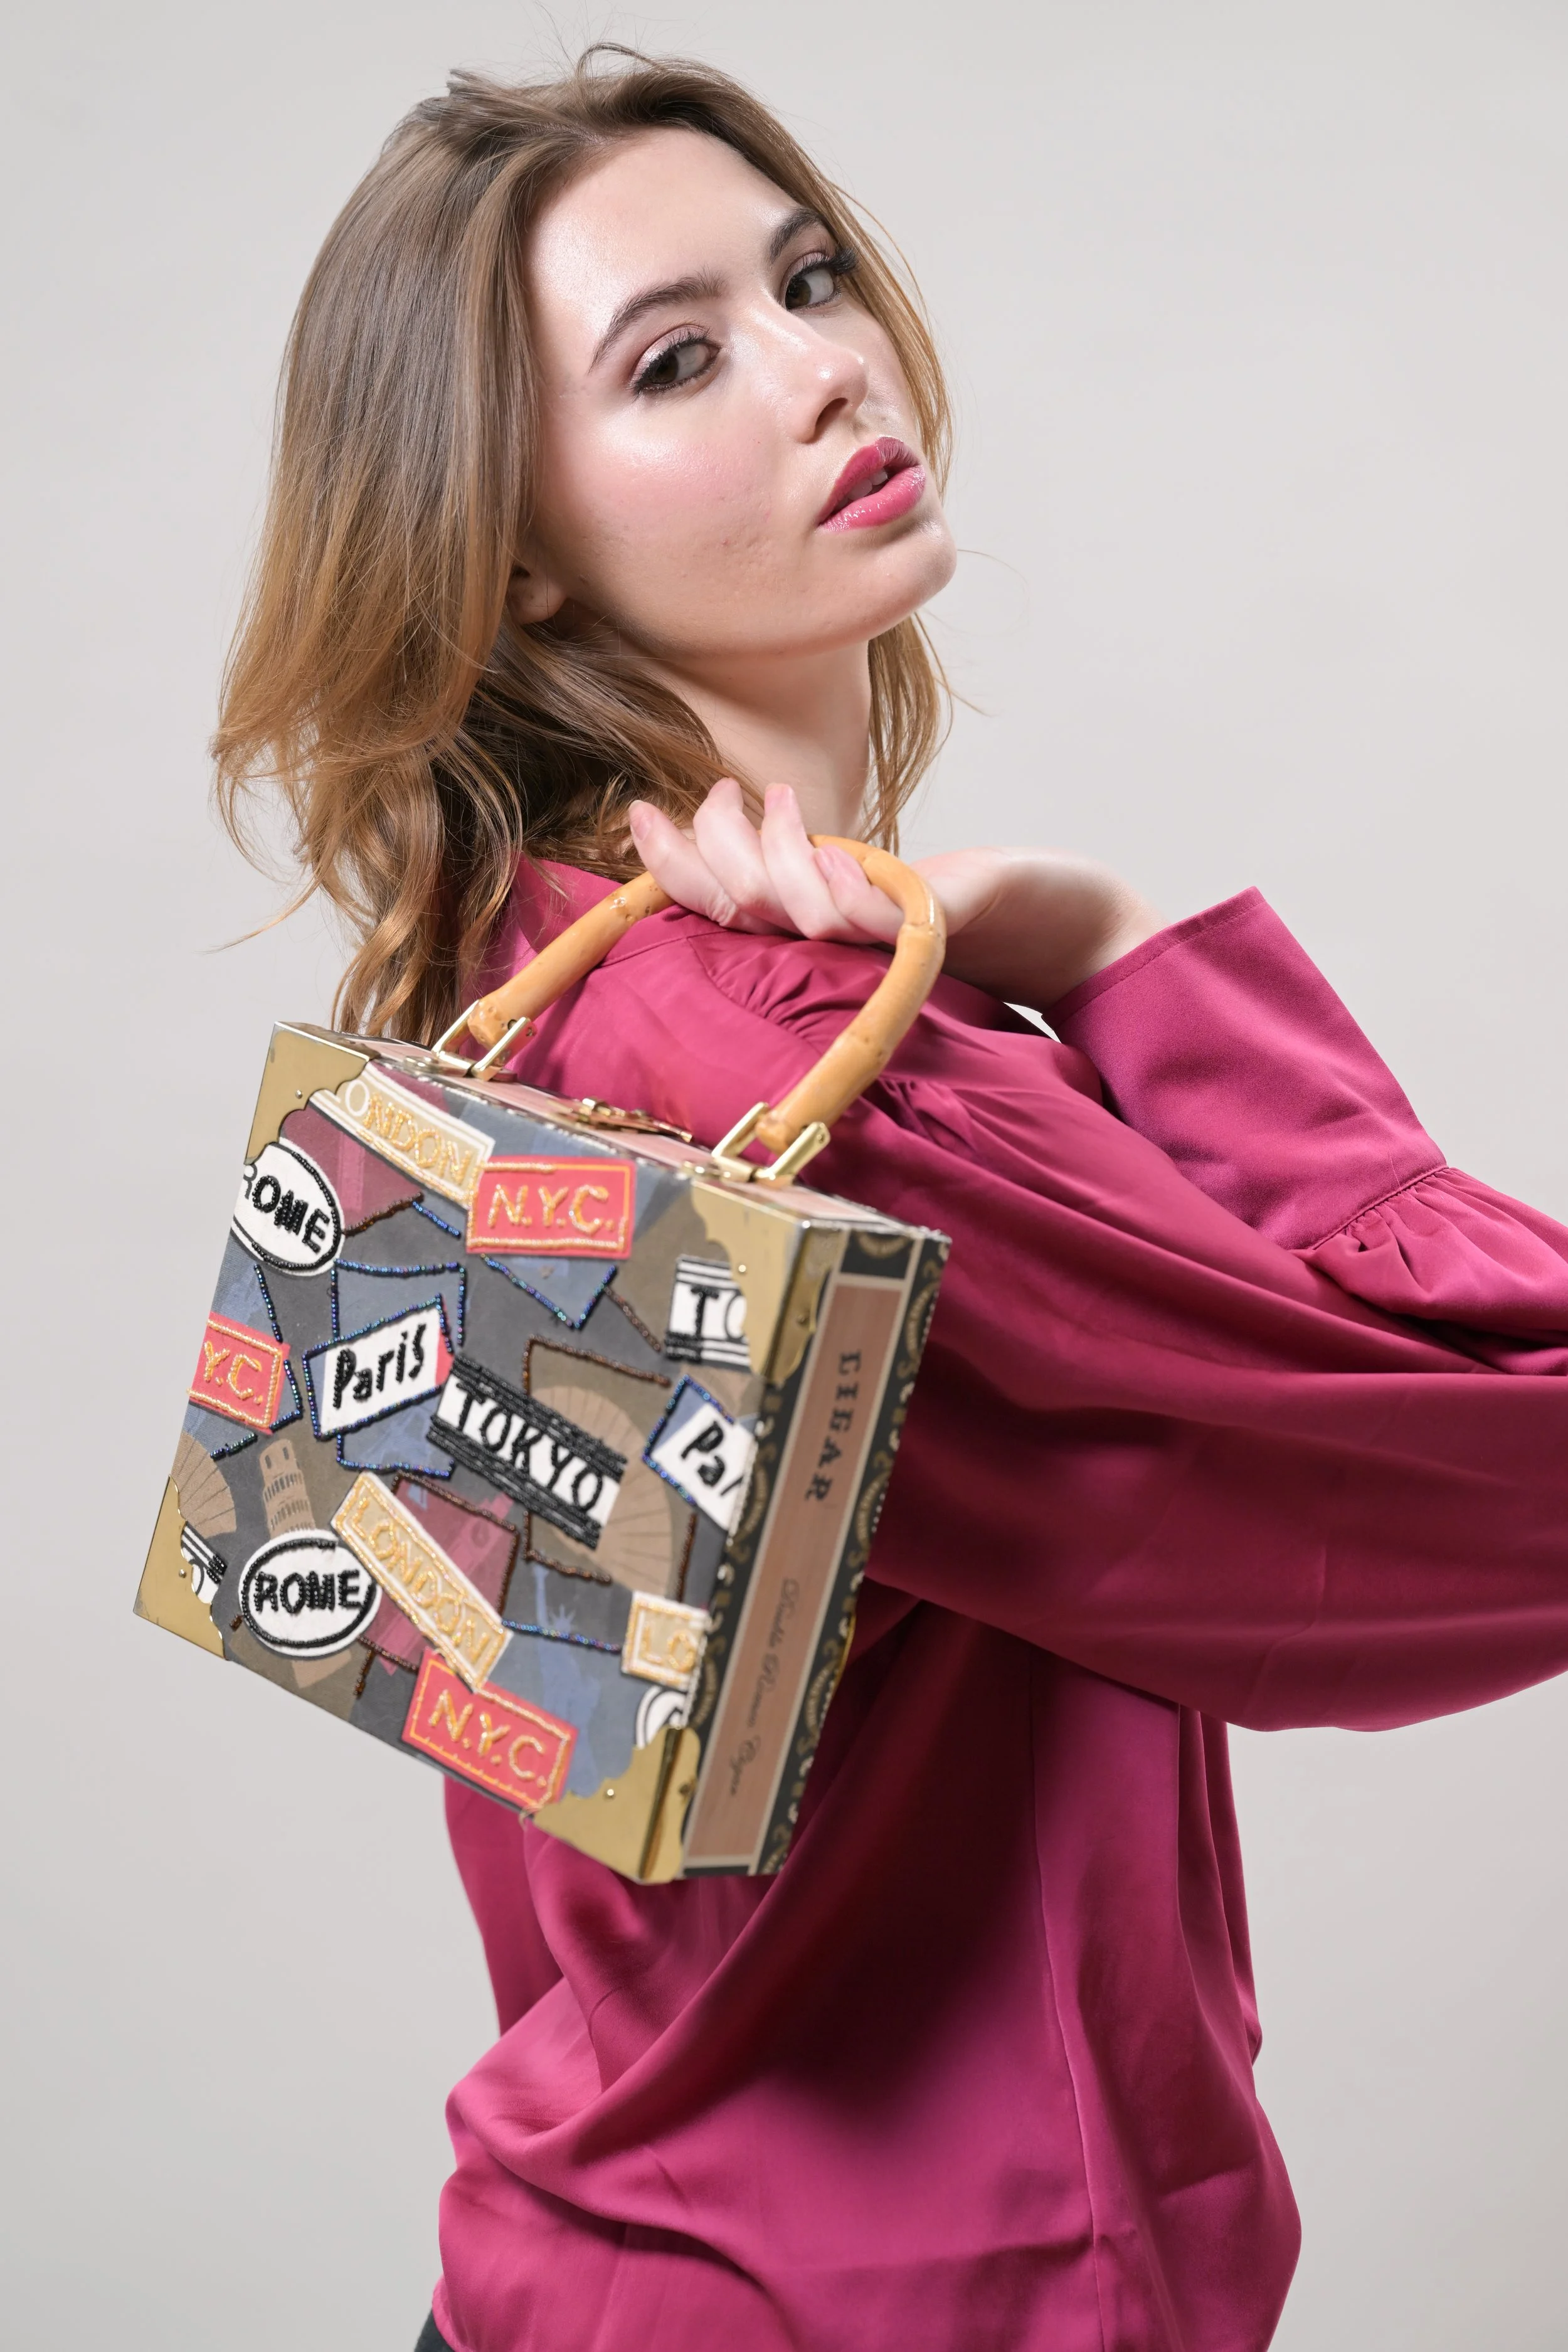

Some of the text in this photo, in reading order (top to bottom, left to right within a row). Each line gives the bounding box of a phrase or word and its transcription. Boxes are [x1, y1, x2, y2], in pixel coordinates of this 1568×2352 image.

[325, 1079, 472, 1186] ONDON
[487, 1184, 616, 1234] N.Y.C.
[333, 1322, 428, 1409] Paris
[456, 1382, 603, 1510] TOKYO
[805, 1350, 862, 1501] CIGAR
[253, 1568, 365, 1614] ROME
[349, 1496, 492, 1663] LONDON
[428, 1688, 548, 1788] N.Y.C.
